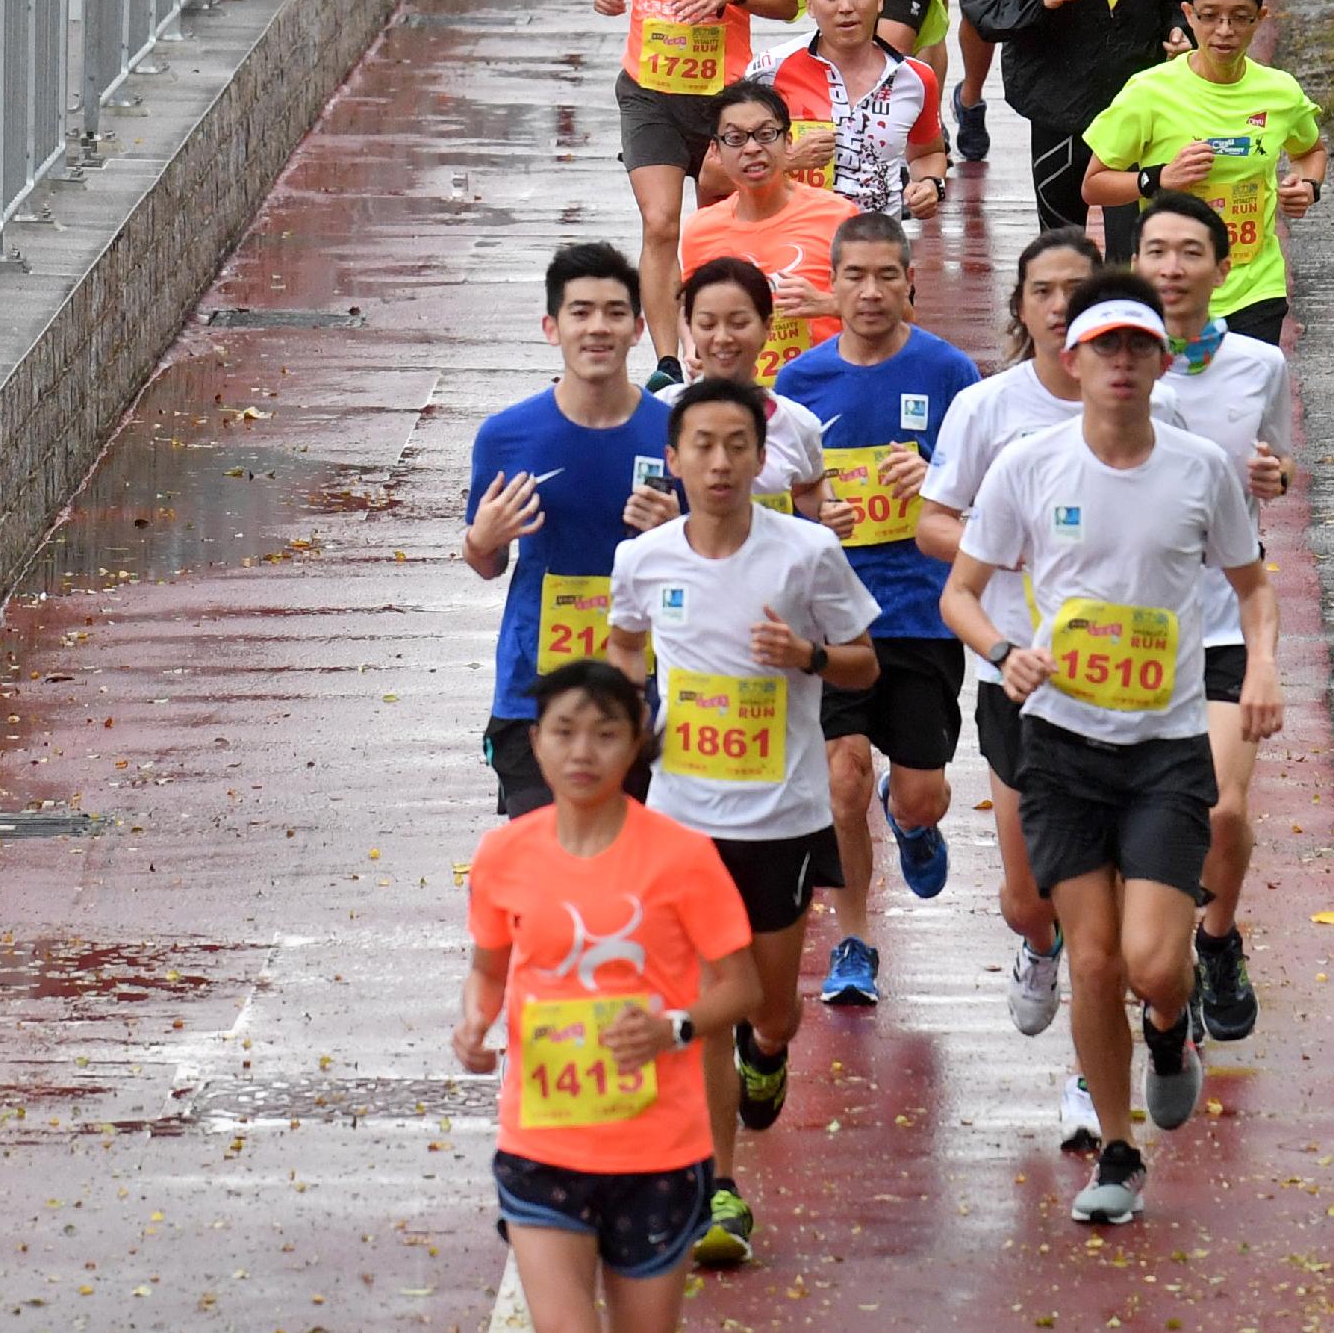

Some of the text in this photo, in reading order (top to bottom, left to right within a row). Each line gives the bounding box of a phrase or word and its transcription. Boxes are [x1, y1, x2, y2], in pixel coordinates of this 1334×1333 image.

[693, 44, 718, 52] RUN
[649, 54, 717, 79] 1728
[1232, 204, 1257, 214] RUN
[1131, 636, 1167, 650] RUN
[1061, 650, 1164, 690] 1510
[738, 706, 775, 718] RUN
[675, 722, 770, 759] 1861
